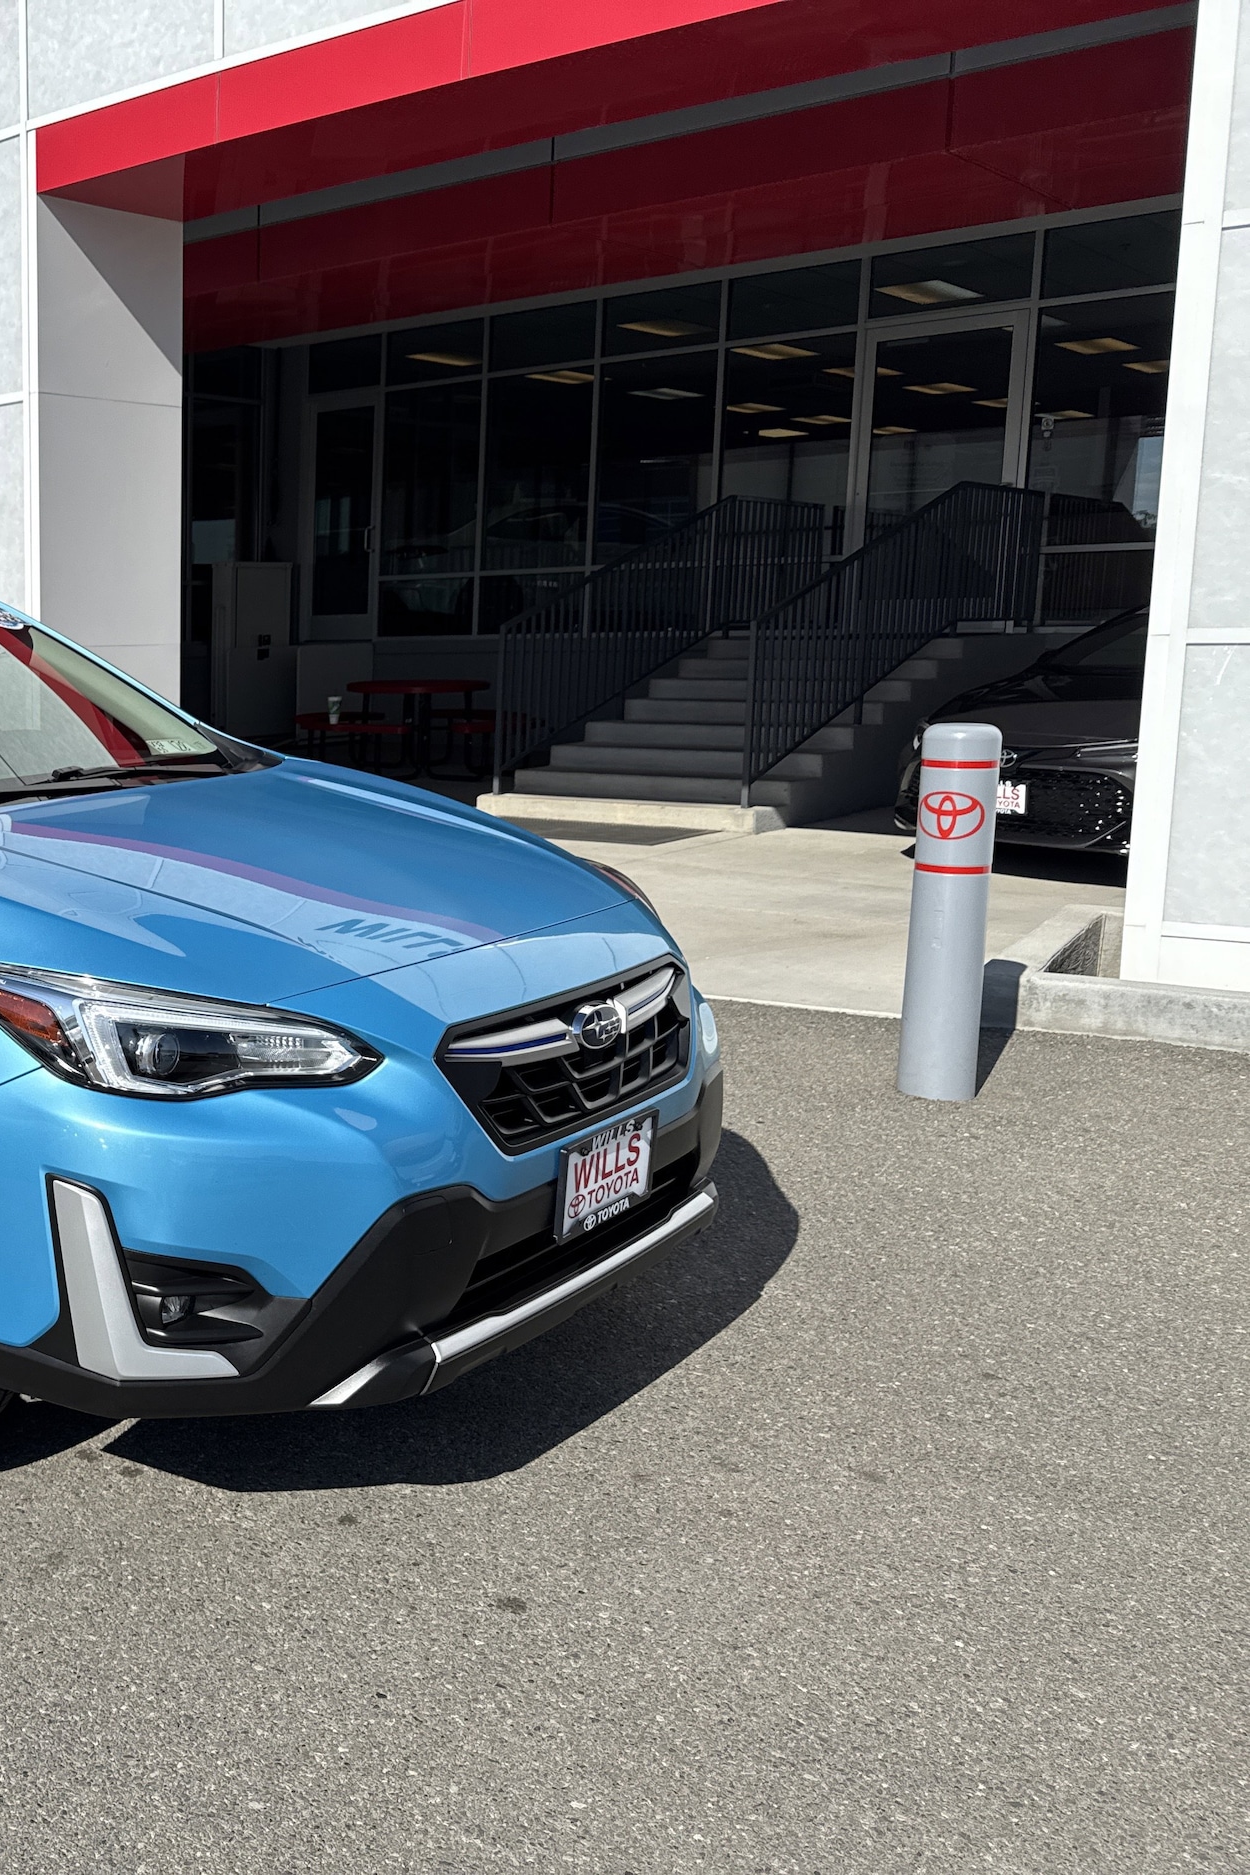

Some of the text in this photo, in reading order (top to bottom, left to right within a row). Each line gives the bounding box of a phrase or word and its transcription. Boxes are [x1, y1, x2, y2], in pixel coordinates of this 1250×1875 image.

[997, 800, 1021, 809] YOTA
[591, 1119, 636, 1151] WILLS
[573, 1132, 641, 1194] WILLS
[587, 1167, 639, 1209] TOYOTA
[597, 1197, 630, 1224] TOYOTA
